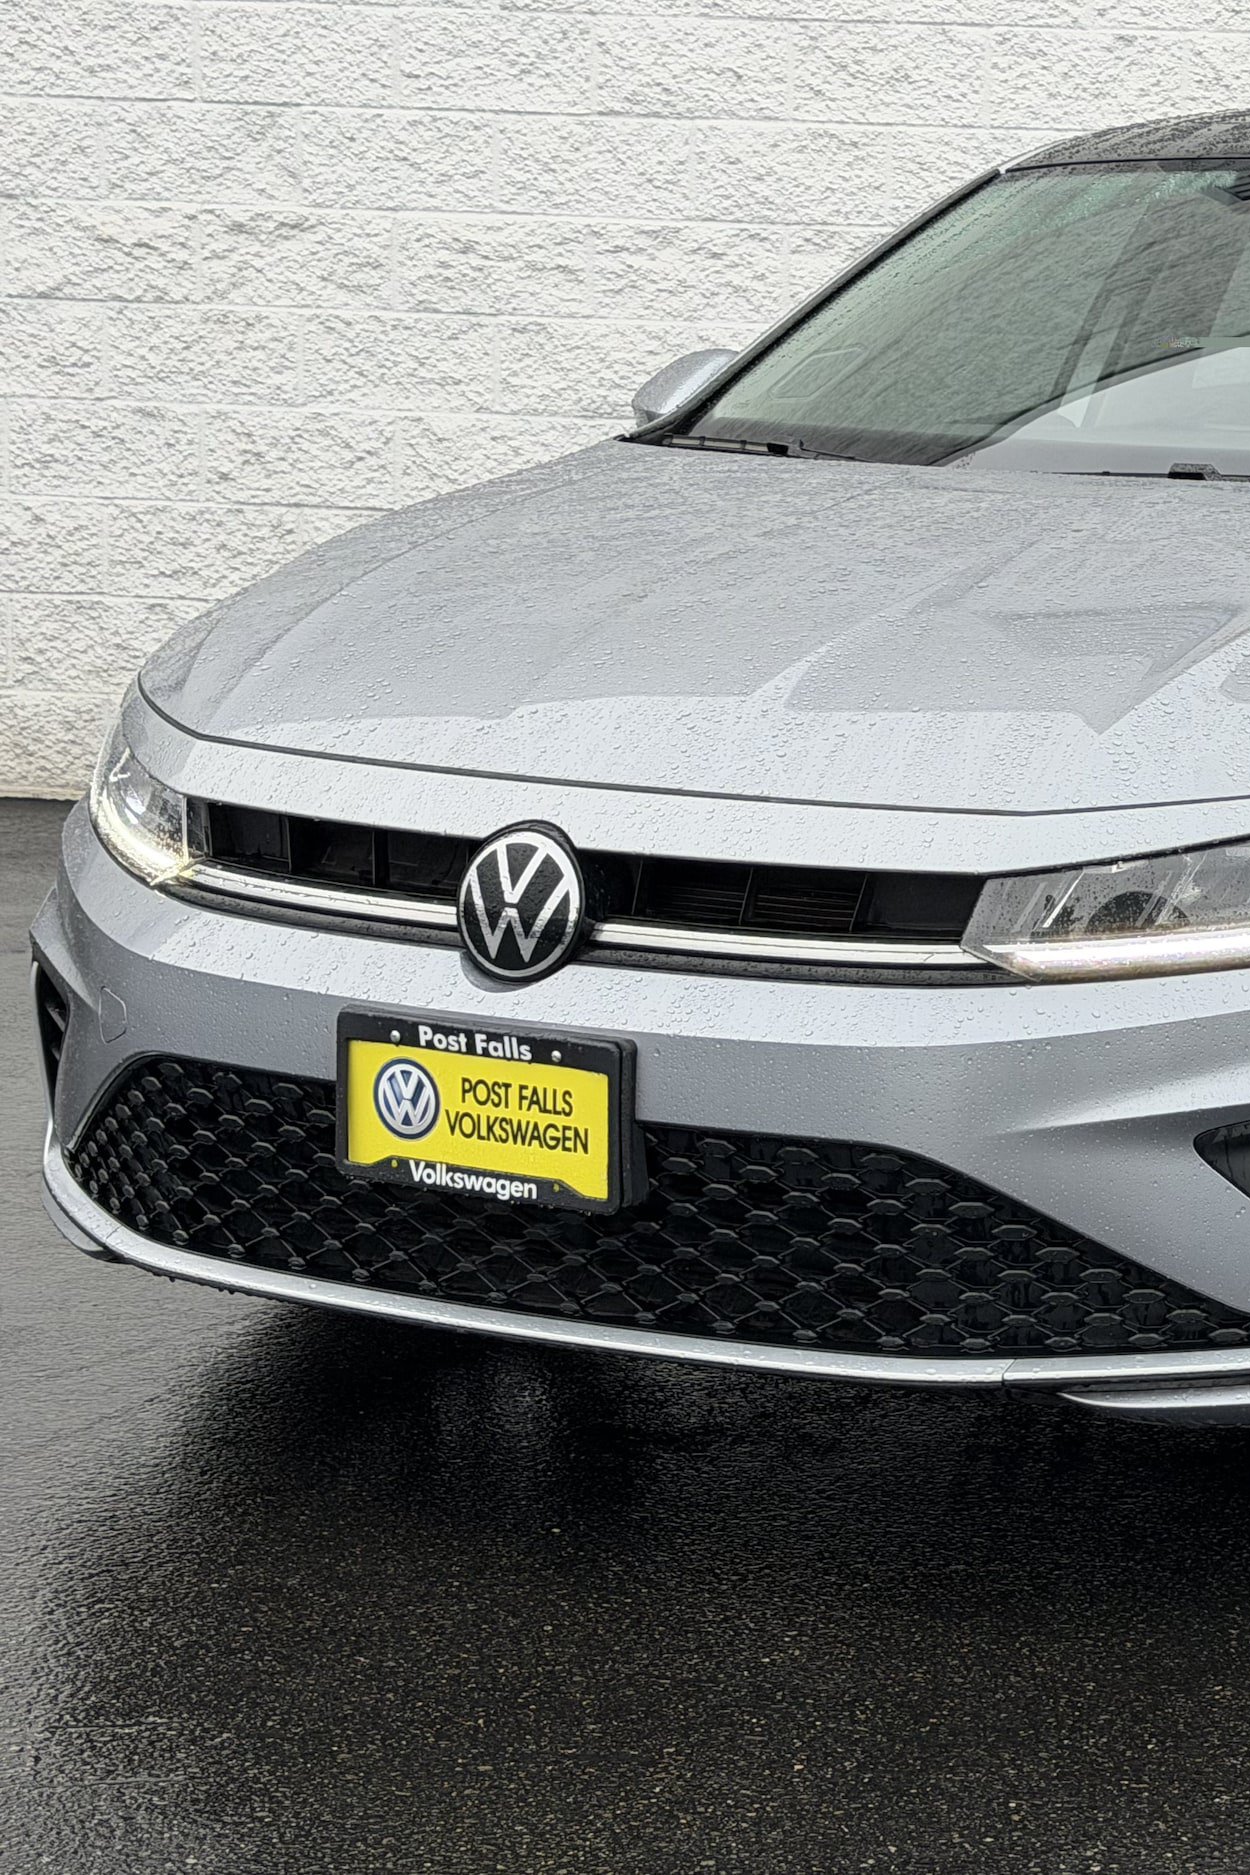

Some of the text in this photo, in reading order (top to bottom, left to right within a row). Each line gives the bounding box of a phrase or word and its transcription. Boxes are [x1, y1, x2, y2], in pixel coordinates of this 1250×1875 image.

[418, 1025, 532, 1061] Post Falls
[461, 1077, 573, 1117] POST FALLS
[445, 1109, 589, 1155] VOLKSWAGEN
[409, 1160, 537, 1200] Volkswagen
